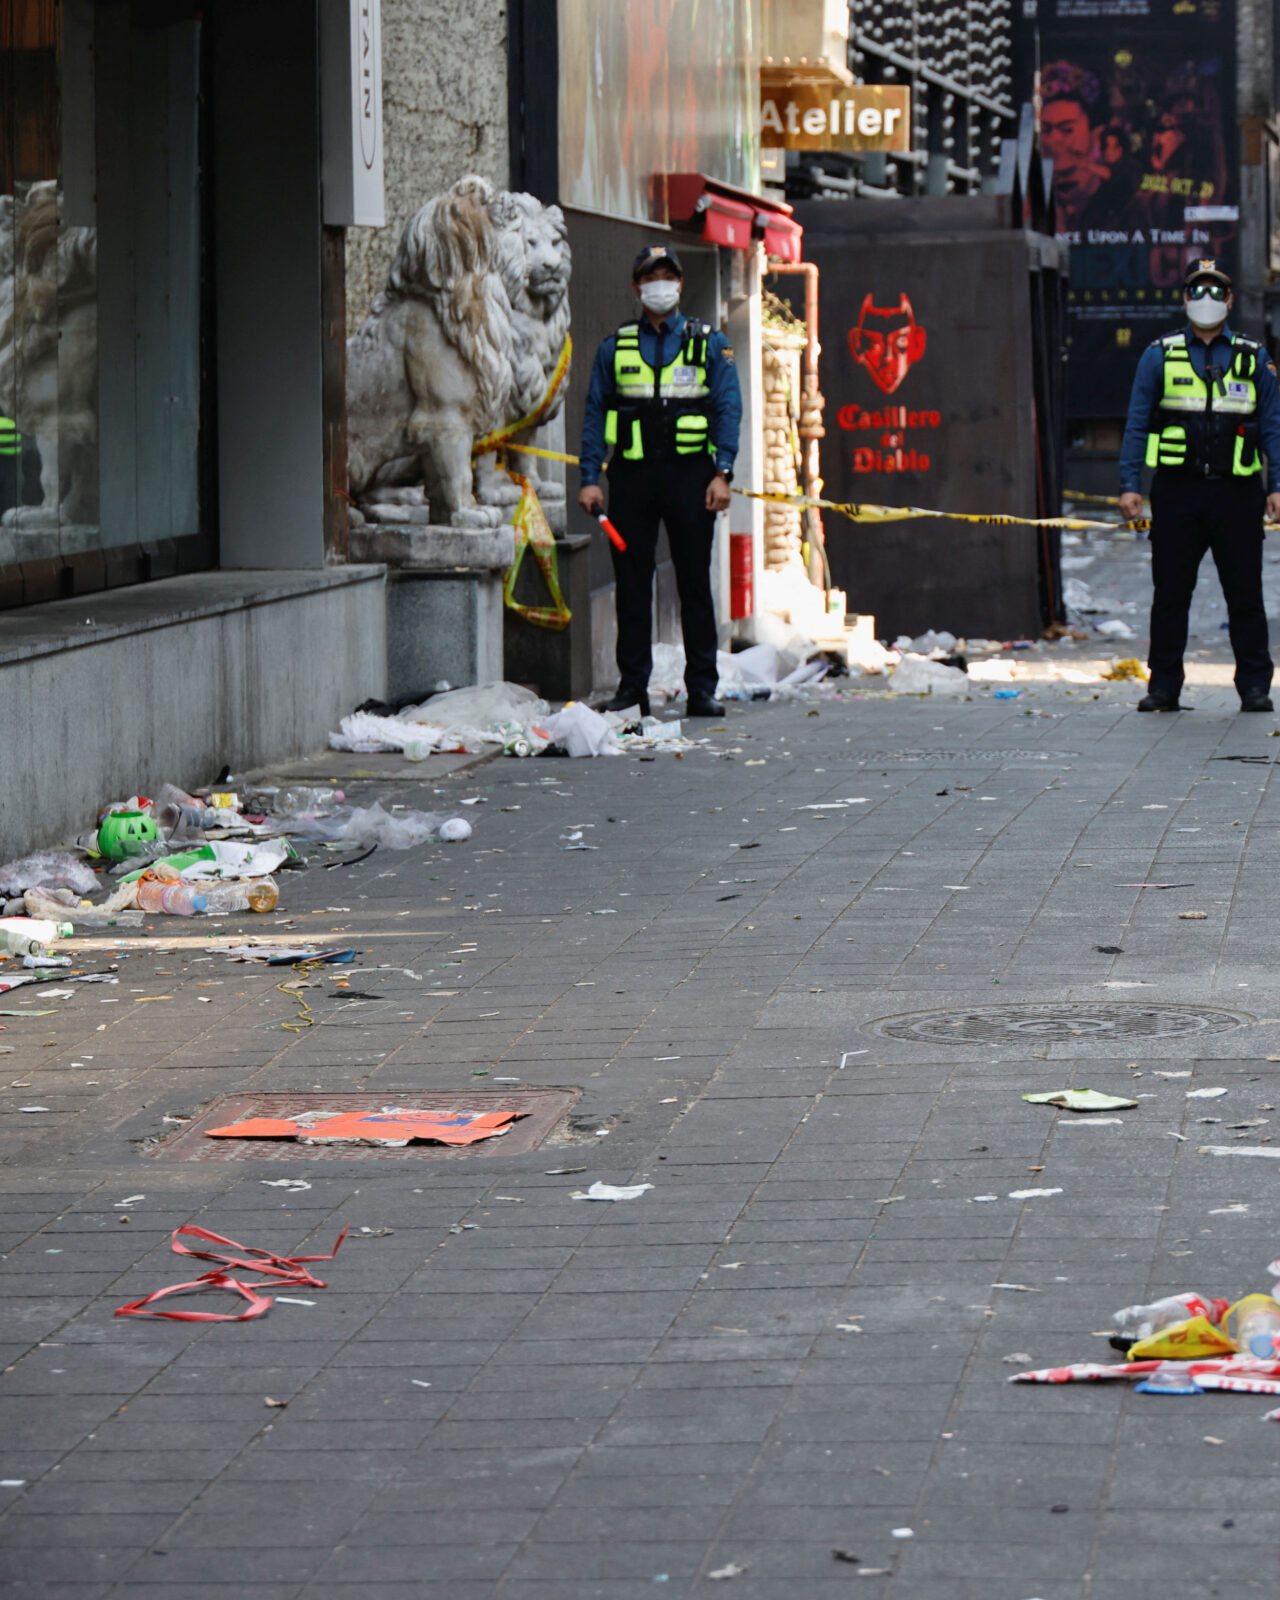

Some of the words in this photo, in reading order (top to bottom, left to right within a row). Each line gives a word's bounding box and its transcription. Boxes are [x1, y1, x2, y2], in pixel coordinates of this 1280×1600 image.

[760, 100, 901, 136] Atelier
[1055, 231, 1082, 244] NCE
[1131, 230, 1145, 244] A
[837, 404, 941, 431] Casillero
[853, 447, 930, 473] Diablo
